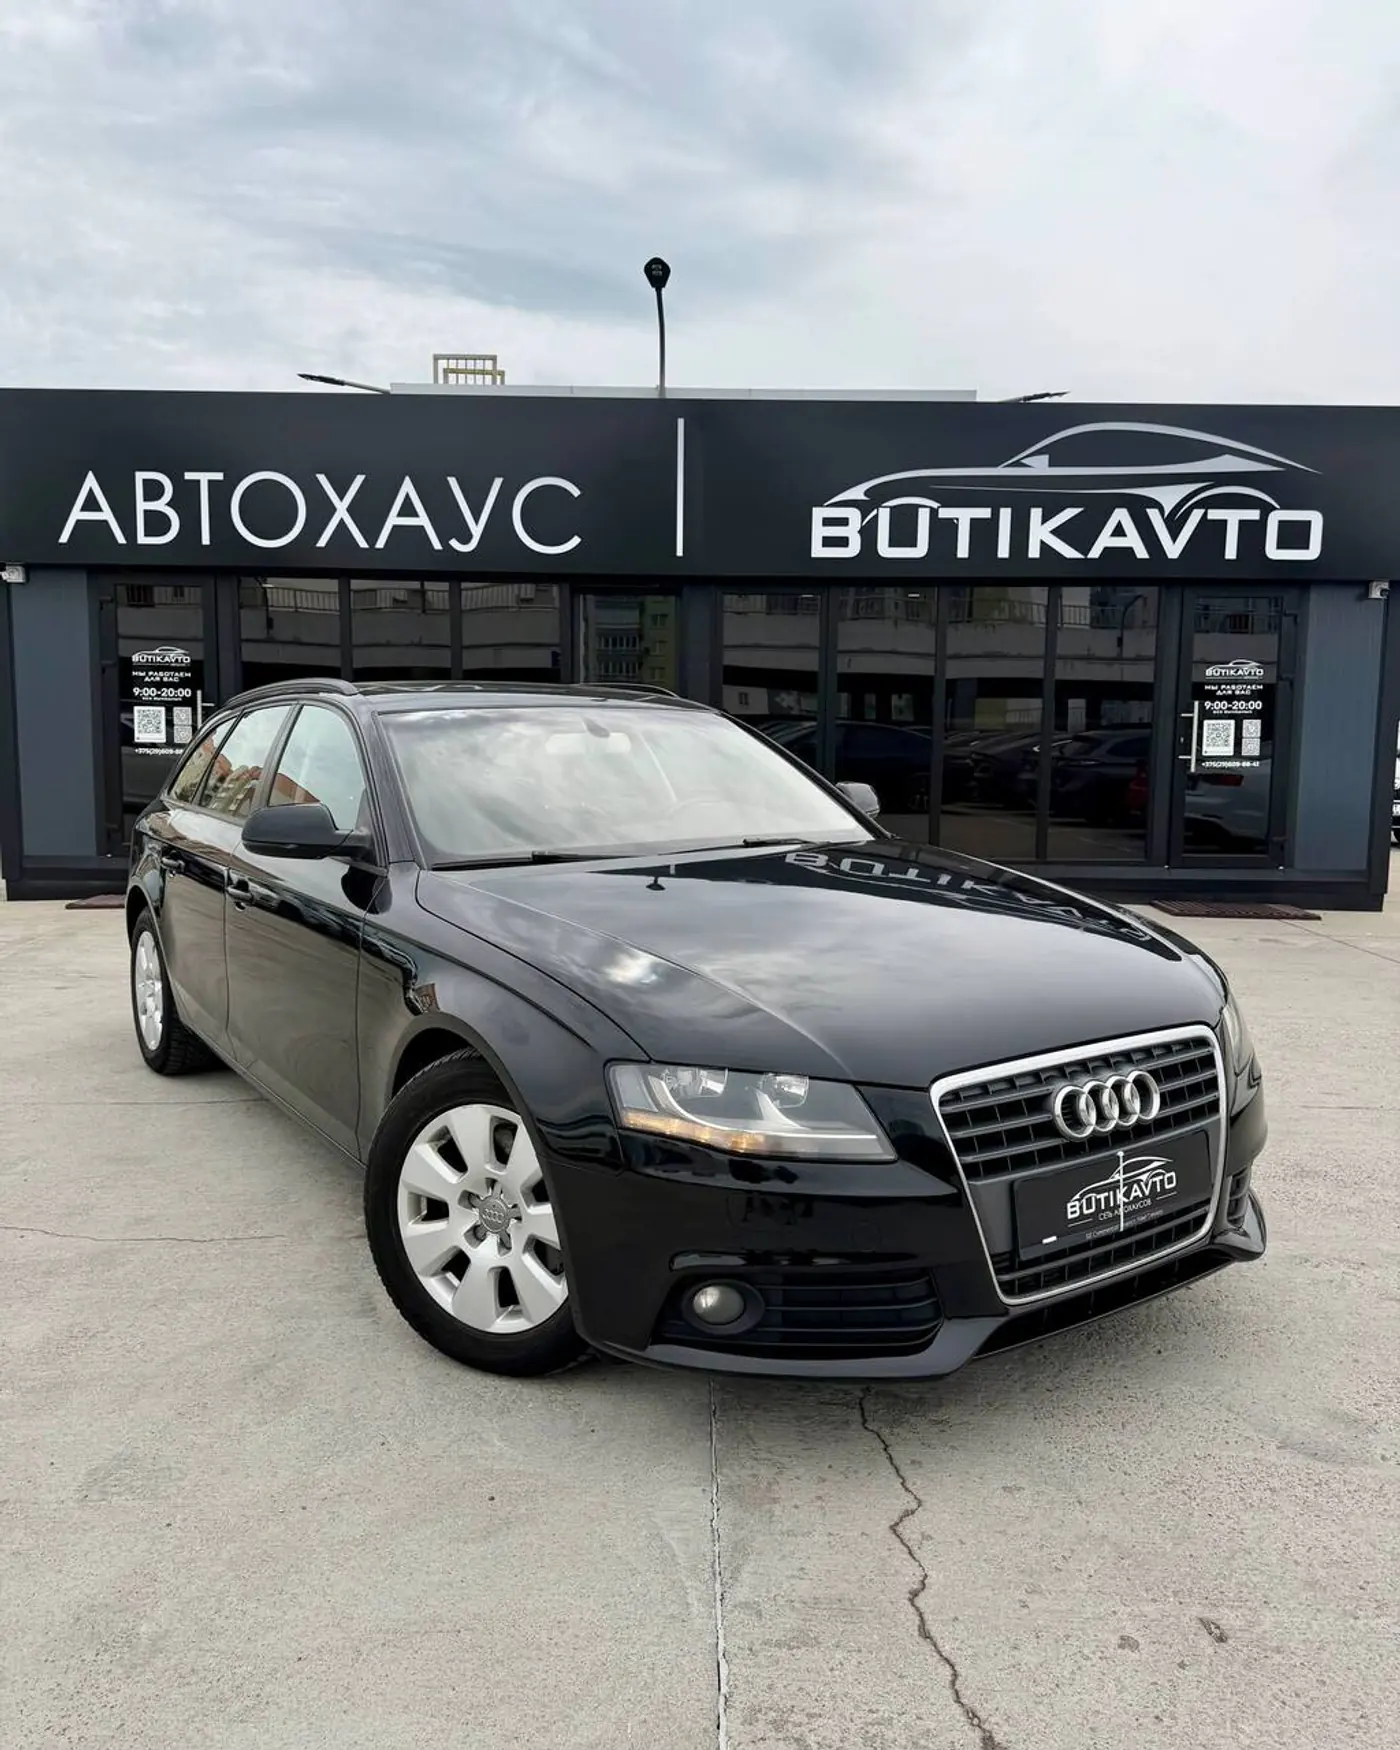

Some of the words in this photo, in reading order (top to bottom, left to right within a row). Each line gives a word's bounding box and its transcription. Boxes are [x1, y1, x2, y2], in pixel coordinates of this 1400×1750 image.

[58, 469, 583, 556] АВТОХАУС
[810, 505, 1324, 561] BUTIKAVTO
[131, 654, 191, 663] BUTIKAVTO
[1205, 668, 1264, 676] BUTIKAVTO
[132, 687, 192, 697] 9:00-20:00
[1204, 700, 1263, 710] 9:00-20:00
[1066, 1171, 1177, 1220] BUTIKAVTO
